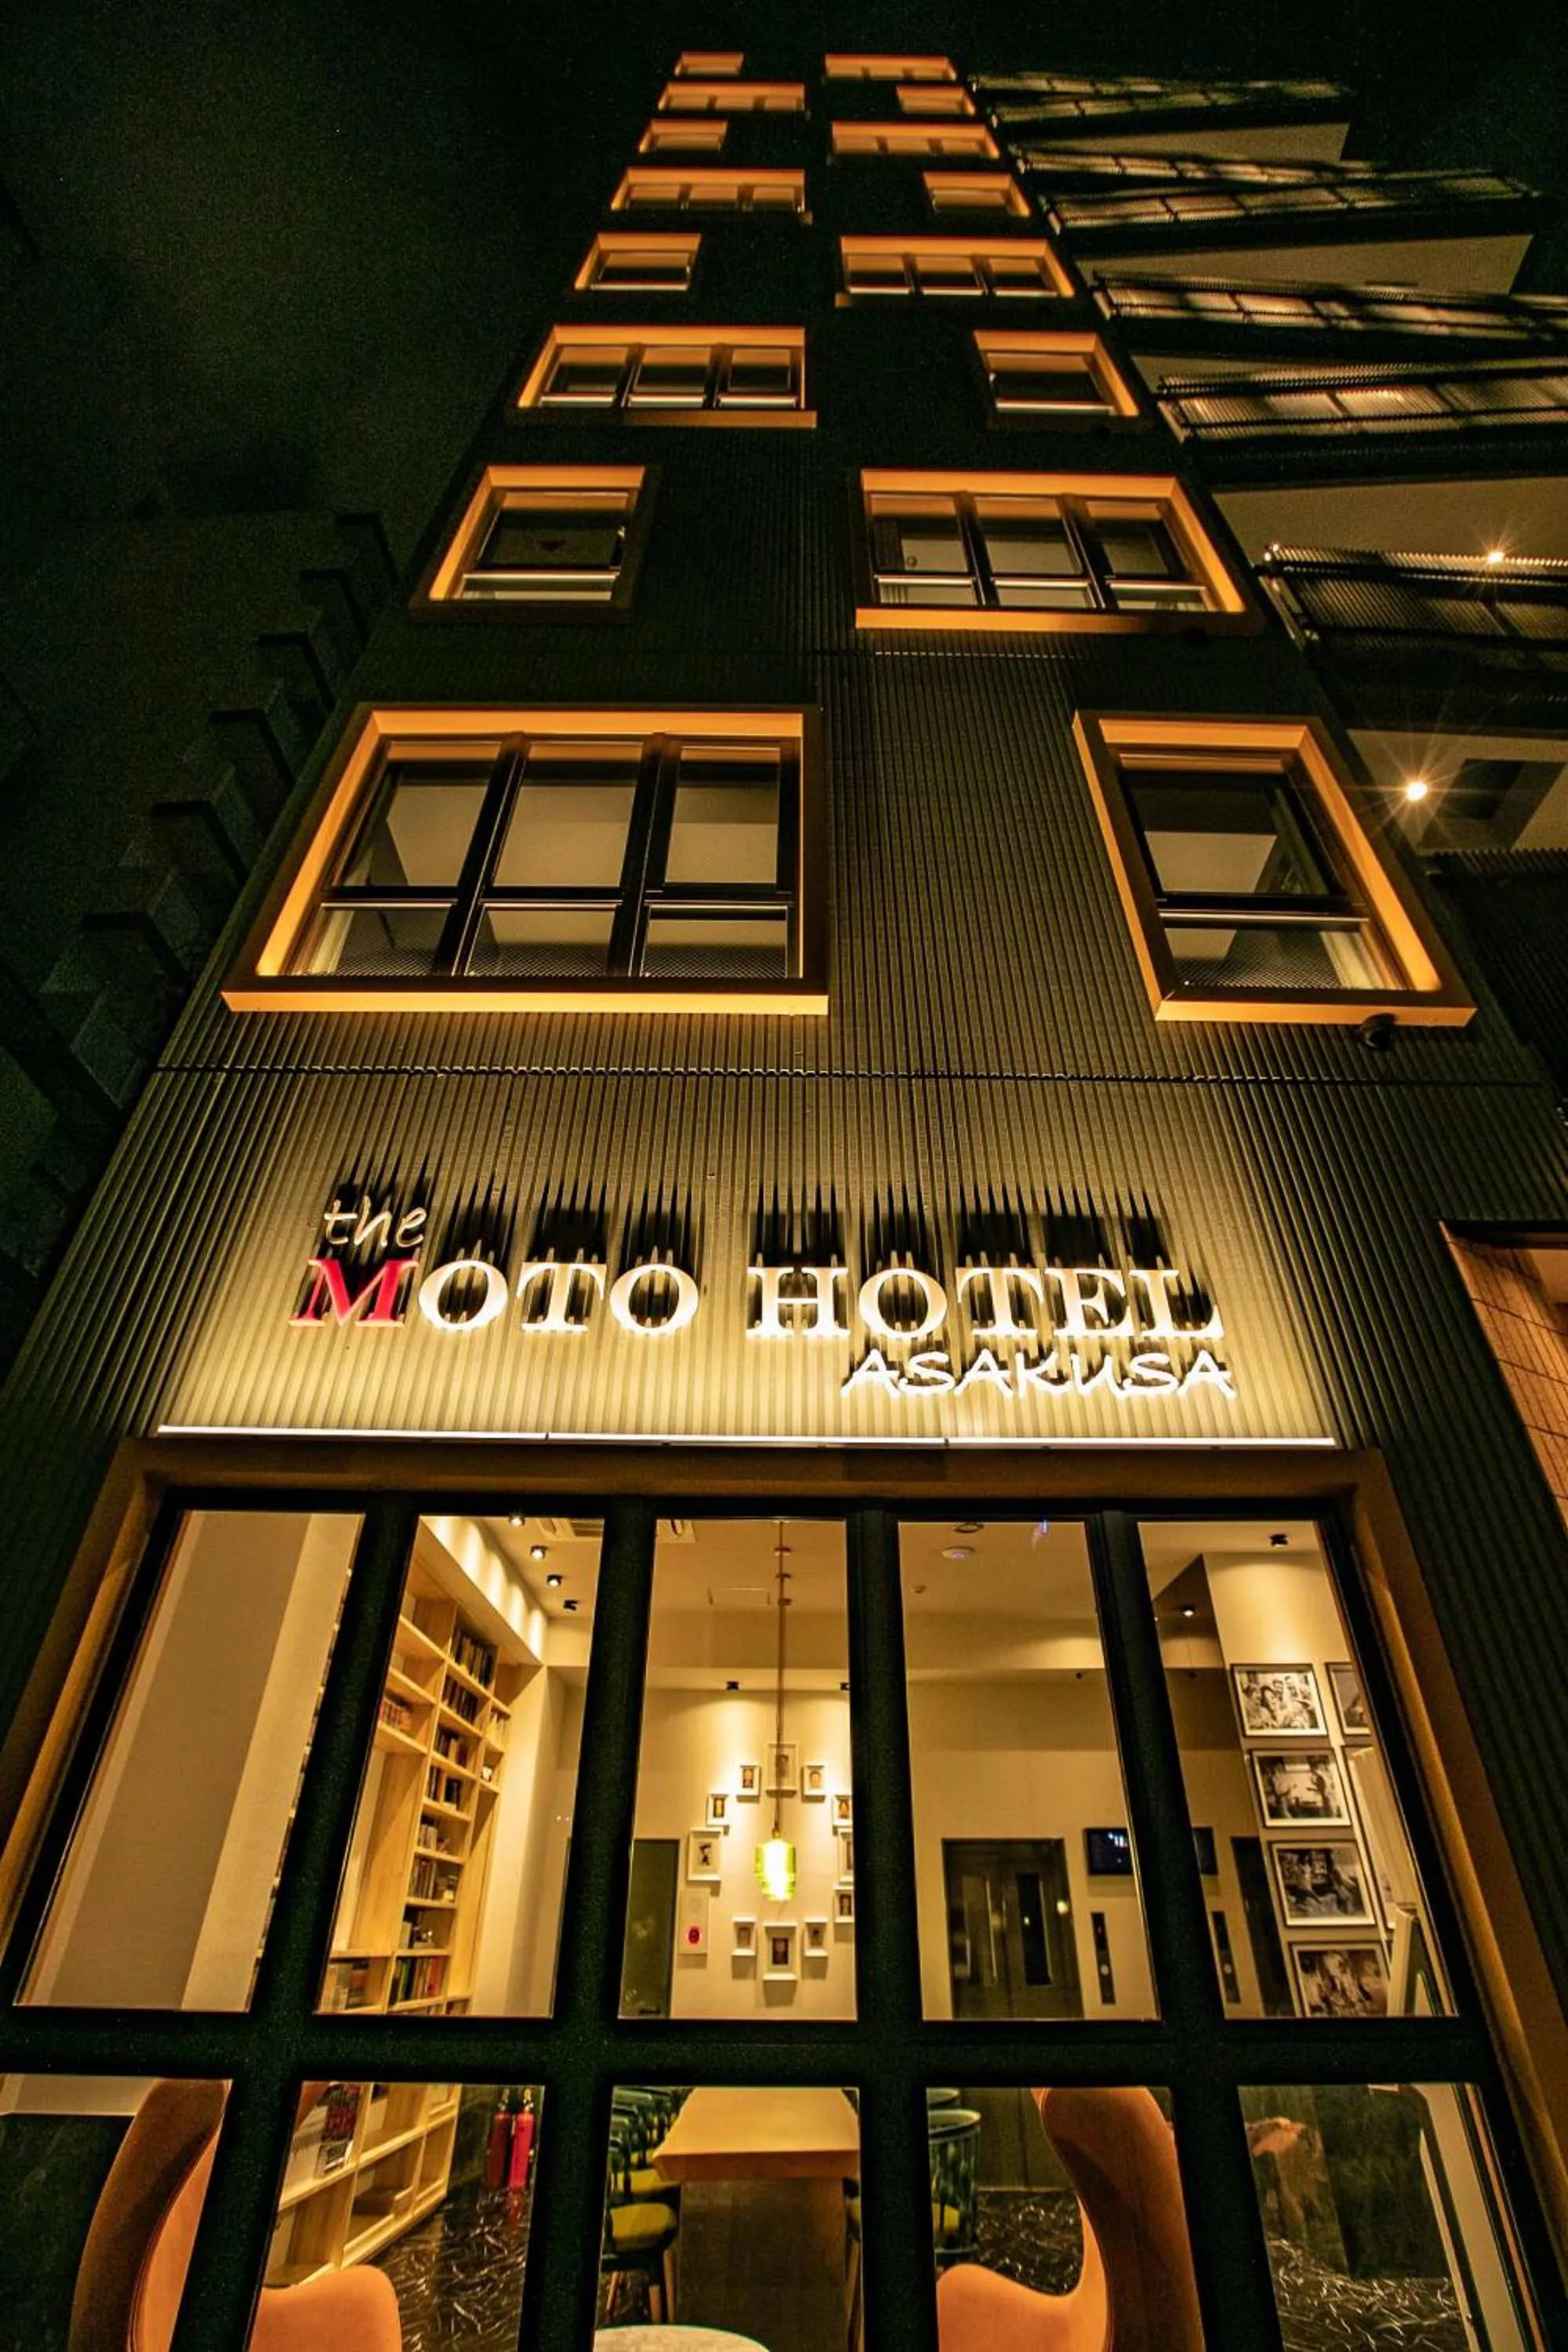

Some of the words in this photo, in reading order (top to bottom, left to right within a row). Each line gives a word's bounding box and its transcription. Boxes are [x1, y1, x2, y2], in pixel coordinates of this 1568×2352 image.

[323, 1195, 427, 1248] the
[288, 1257, 699, 1334] MOTO
[746, 1266, 1225, 1340] HOTEL
[840, 1348, 1237, 1399] ASAKUSA
